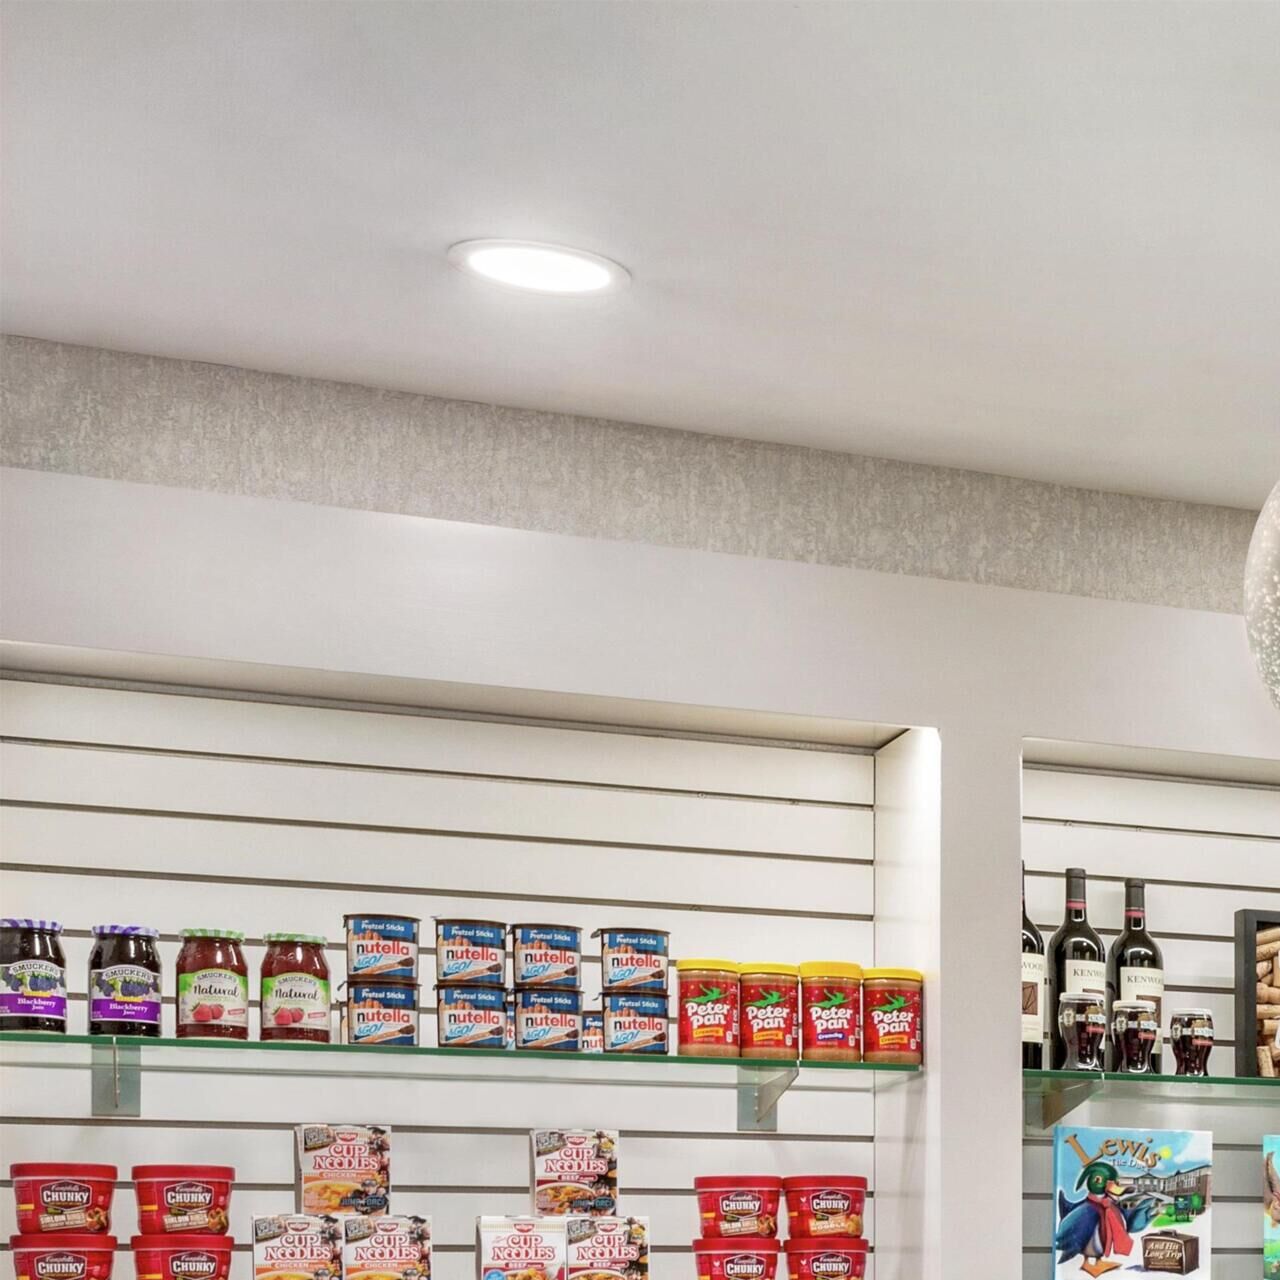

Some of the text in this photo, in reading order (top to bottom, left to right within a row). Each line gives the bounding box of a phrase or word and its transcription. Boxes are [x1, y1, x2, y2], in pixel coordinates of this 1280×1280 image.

[362, 921, 405, 932] Pretzel Sticks
[452, 927, 495, 938] Pretzel Sticks
[356, 940, 410, 956] nutella
[447, 947, 498, 962] nutella
[525, 950, 575, 966] nutella
[611, 955, 661, 969] nutella
[193, 983, 240, 998] Natural
[274, 988, 320, 1001] Natural
[17, 998, 56, 1009] Blackberry
[109, 1002, 148, 1013] Blackberry
[686, 1001, 730, 1017] Peter
[356, 1009, 410, 1024] nutella
[448, 1009, 500, 1024] nutella
[746, 1005, 790, 1021] Peter
[810, 1005, 853, 1021] Peter
[871, 1010, 914, 1026] Peter
[525, 1013, 576, 1028] nutella
[613, 1017, 663, 1031] nutella
[329, 1144, 369, 1157] CUP
[560, 1148, 594, 1160] CUP
[1065, 1133, 1162, 1168] Lewis
[313, 1155, 379, 1170] NOODLES
[545, 1159, 607, 1173] NOODLES
[43, 1190, 88, 1203] CHUNKY
[167, 1191, 211, 1203] CHUNKY
[722, 1200, 760, 1211] CHUNKY
[813, 1198, 849, 1210] CHUNKY
[281, 1234, 321, 1247] CUP
[370, 1234, 409, 1248] CUP
[507, 1235, 542, 1248] CUP
[591, 1235, 625, 1248] CUP
[265, 1247, 331, 1261] NOODLES
[355, 1247, 421, 1261] NOODLES
[492, 1247, 555, 1260] NOODLES
[577, 1247, 639, 1260] NOODLES
[38, 1261, 84, 1274] CHUNKY
[173, 1261, 215, 1273] CHUNKY
[726, 1263, 764, 1275] CHUNKY
[812, 1262, 849, 1273] CHUNKY
